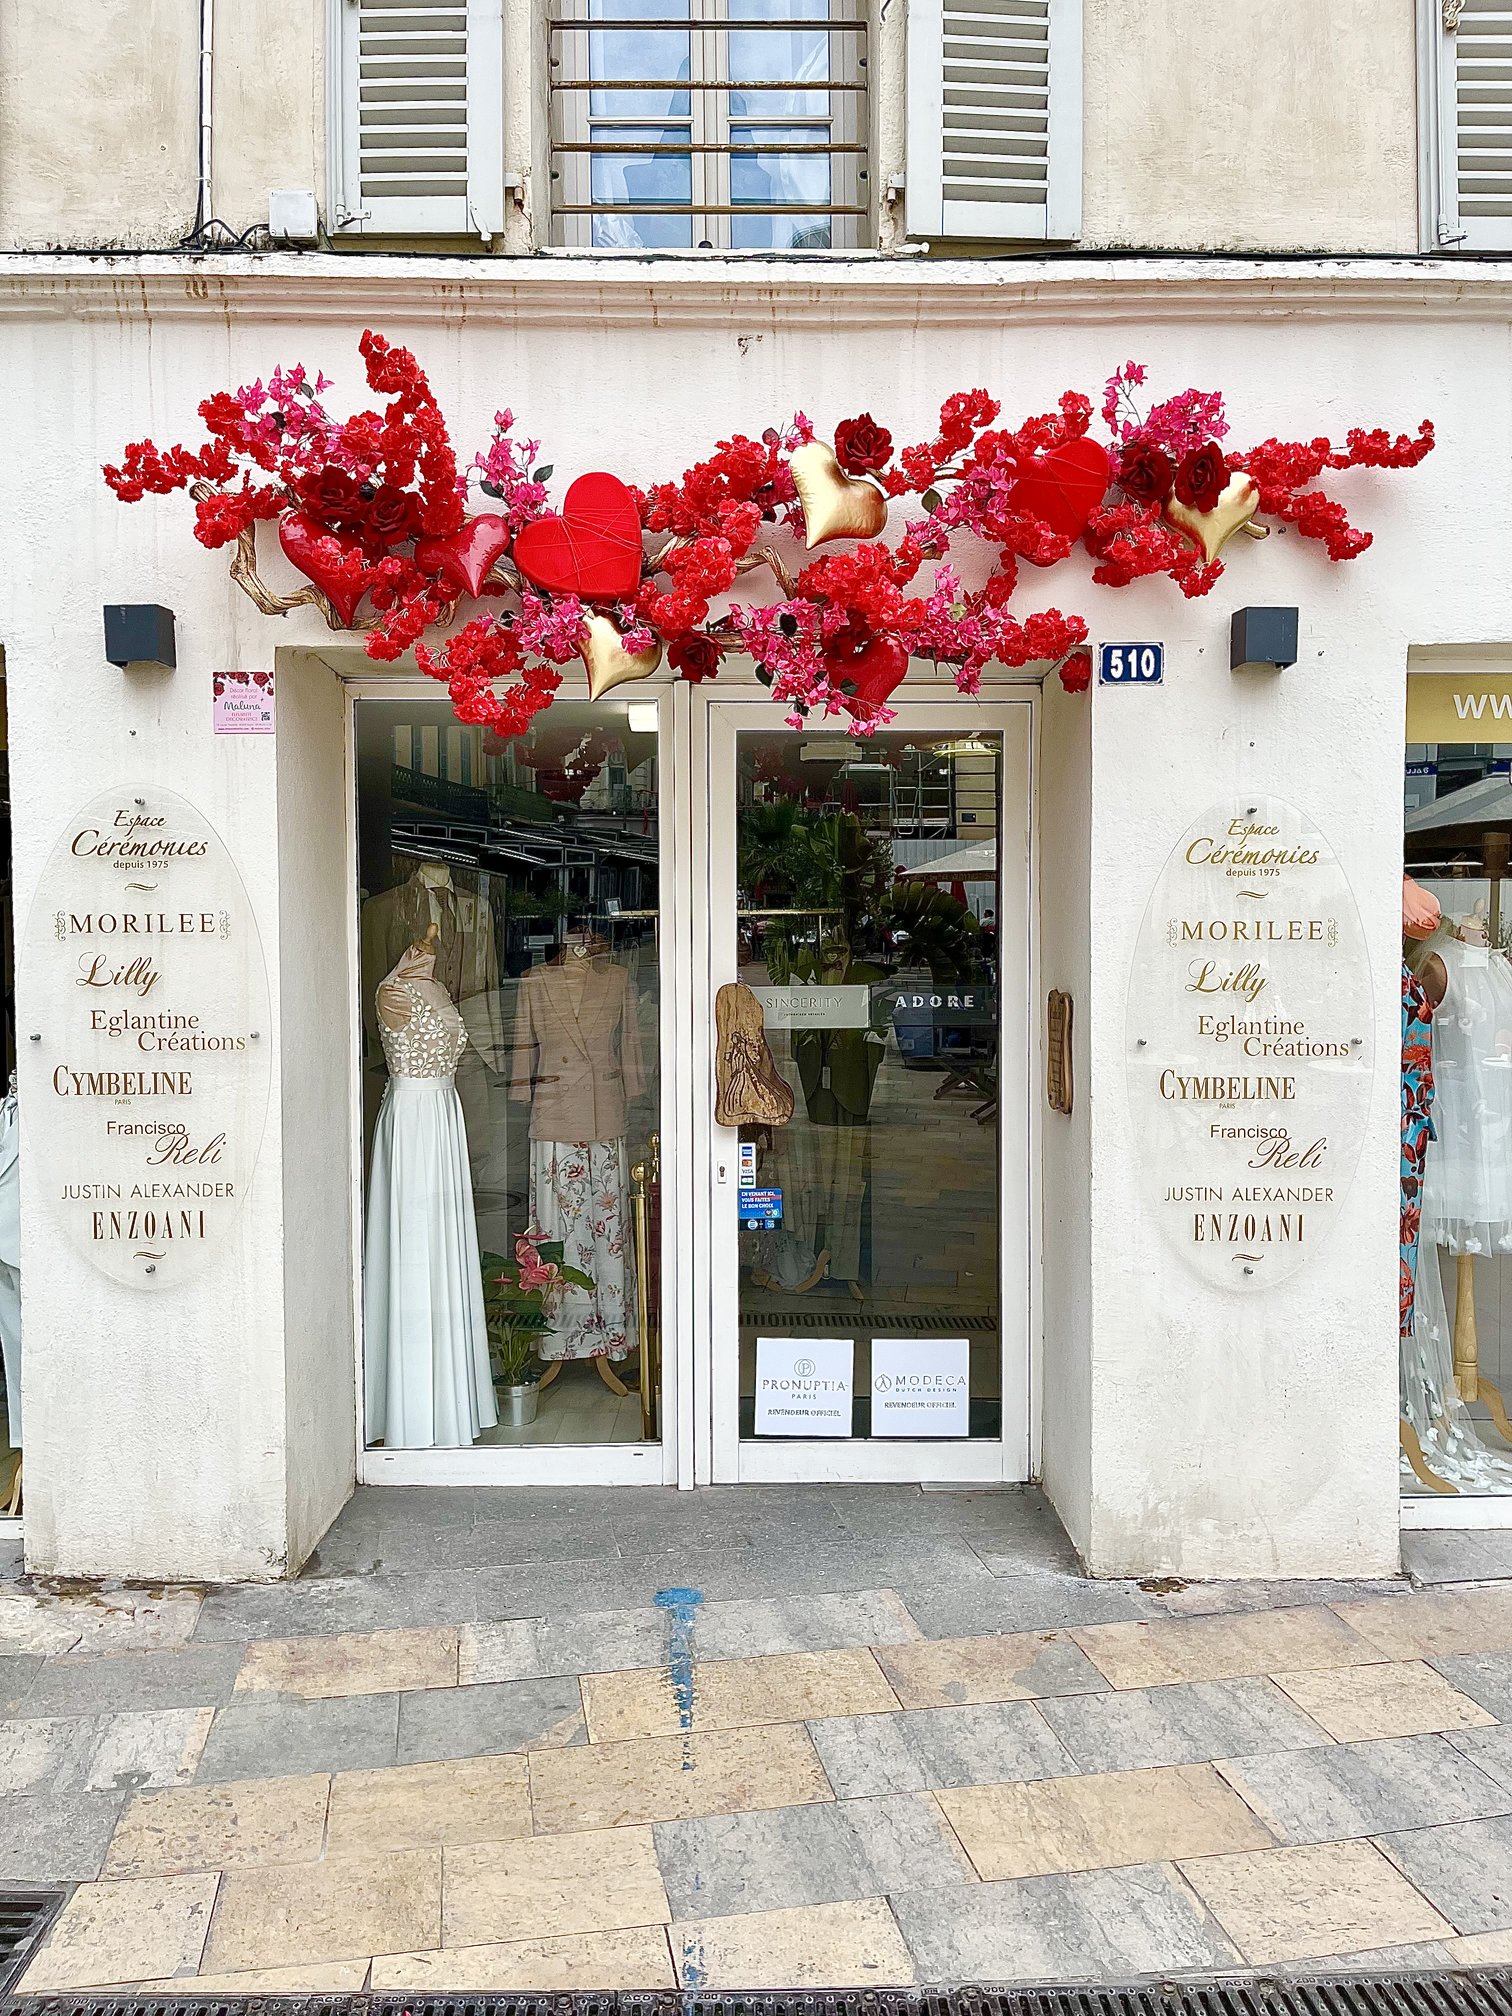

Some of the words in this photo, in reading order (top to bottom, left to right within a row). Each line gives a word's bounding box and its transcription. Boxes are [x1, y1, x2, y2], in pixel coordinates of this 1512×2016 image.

[1110, 649, 1155, 679] 510
[223, 700, 261, 711] Maluna
[113, 809, 168, 836] Espace
[1227, 819, 1279, 845] Espace
[71, 829, 208, 857] Cérémonies
[1185, 838, 1319, 865] Cérémonies
[113, 860, 144, 871] depuis
[147, 860, 169, 869] 1975
[1226, 868, 1256, 877] depuis
[1259, 868, 1280, 877] 1975
[69, 913, 215, 934] MORILEE
[1181, 920, 1324, 941] MORILEE
[75, 951, 162, 997] Lilly
[1185, 958, 1269, 1003] Lilly
[766, 997, 843, 1008] SINCERITY
[895, 995, 974, 1008] ADORE
[90, 1009, 199, 1037] Eglantine
[1198, 1015, 1305, 1042] Eglantine
[137, 1031, 246, 1051] Créations
[1243, 1037, 1349, 1057] Créations
[53, 1065, 192, 1096] CYMBELINE
[1159, 1069, 1296, 1100] CYMBELINE
[107, 1121, 186, 1135] Francisco
[1210, 1124, 1288, 1138] Francisco
[147, 1133, 226, 1165] Reli
[1247, 1137, 1327, 1169] Reli
[62, 1184, 121, 1200] JUSTIN
[130, 1183, 234, 1198] ALEXANDER
[1165, 1187, 1223, 1202] JUSTIN
[1232, 1187, 1334, 1202] ALEXANDER
[93, 1210, 206, 1240] ENZOANI
[1194, 1214, 1305, 1242] ENZOANI
[762, 1379, 847, 1391] PRONUPTIA
[895, 1375, 966, 1386] MODECA
[624, 1994, 651, 2002] ACO
